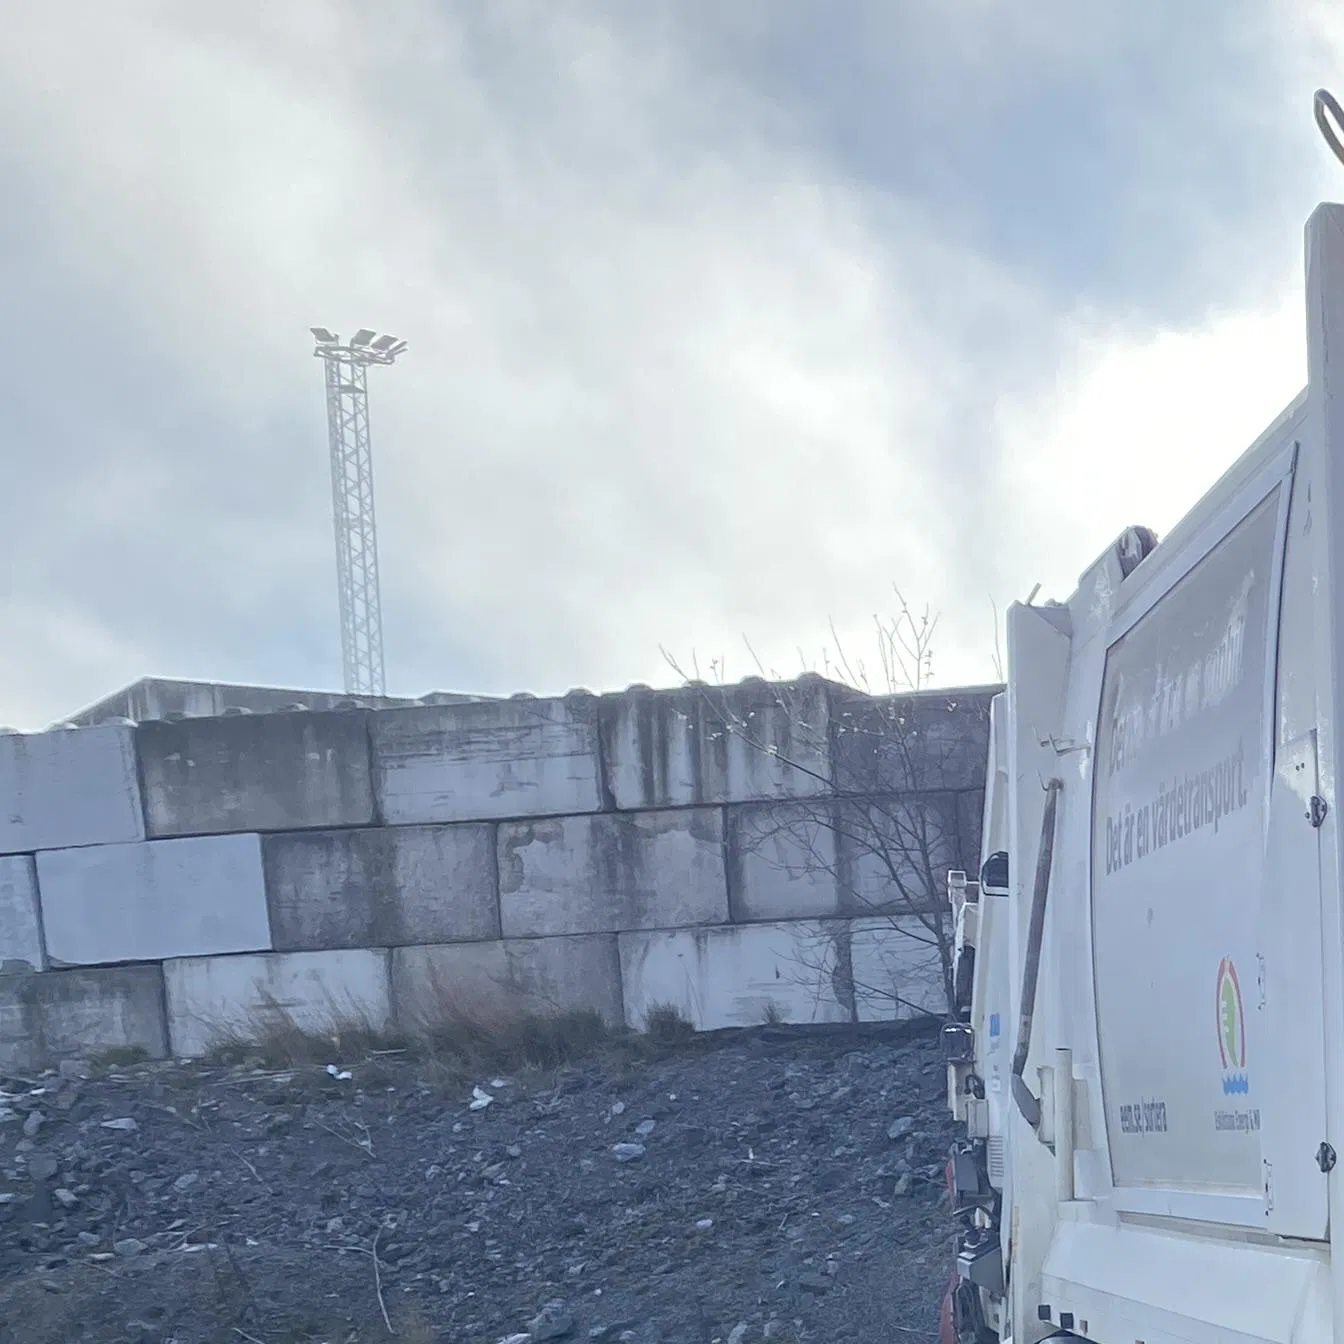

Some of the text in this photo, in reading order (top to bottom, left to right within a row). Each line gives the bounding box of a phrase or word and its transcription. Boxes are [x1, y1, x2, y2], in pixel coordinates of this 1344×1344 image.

[1106, 812, 1122, 876] Det
[1124, 802, 1135, 866] är
[1137, 805, 1150, 859] en
